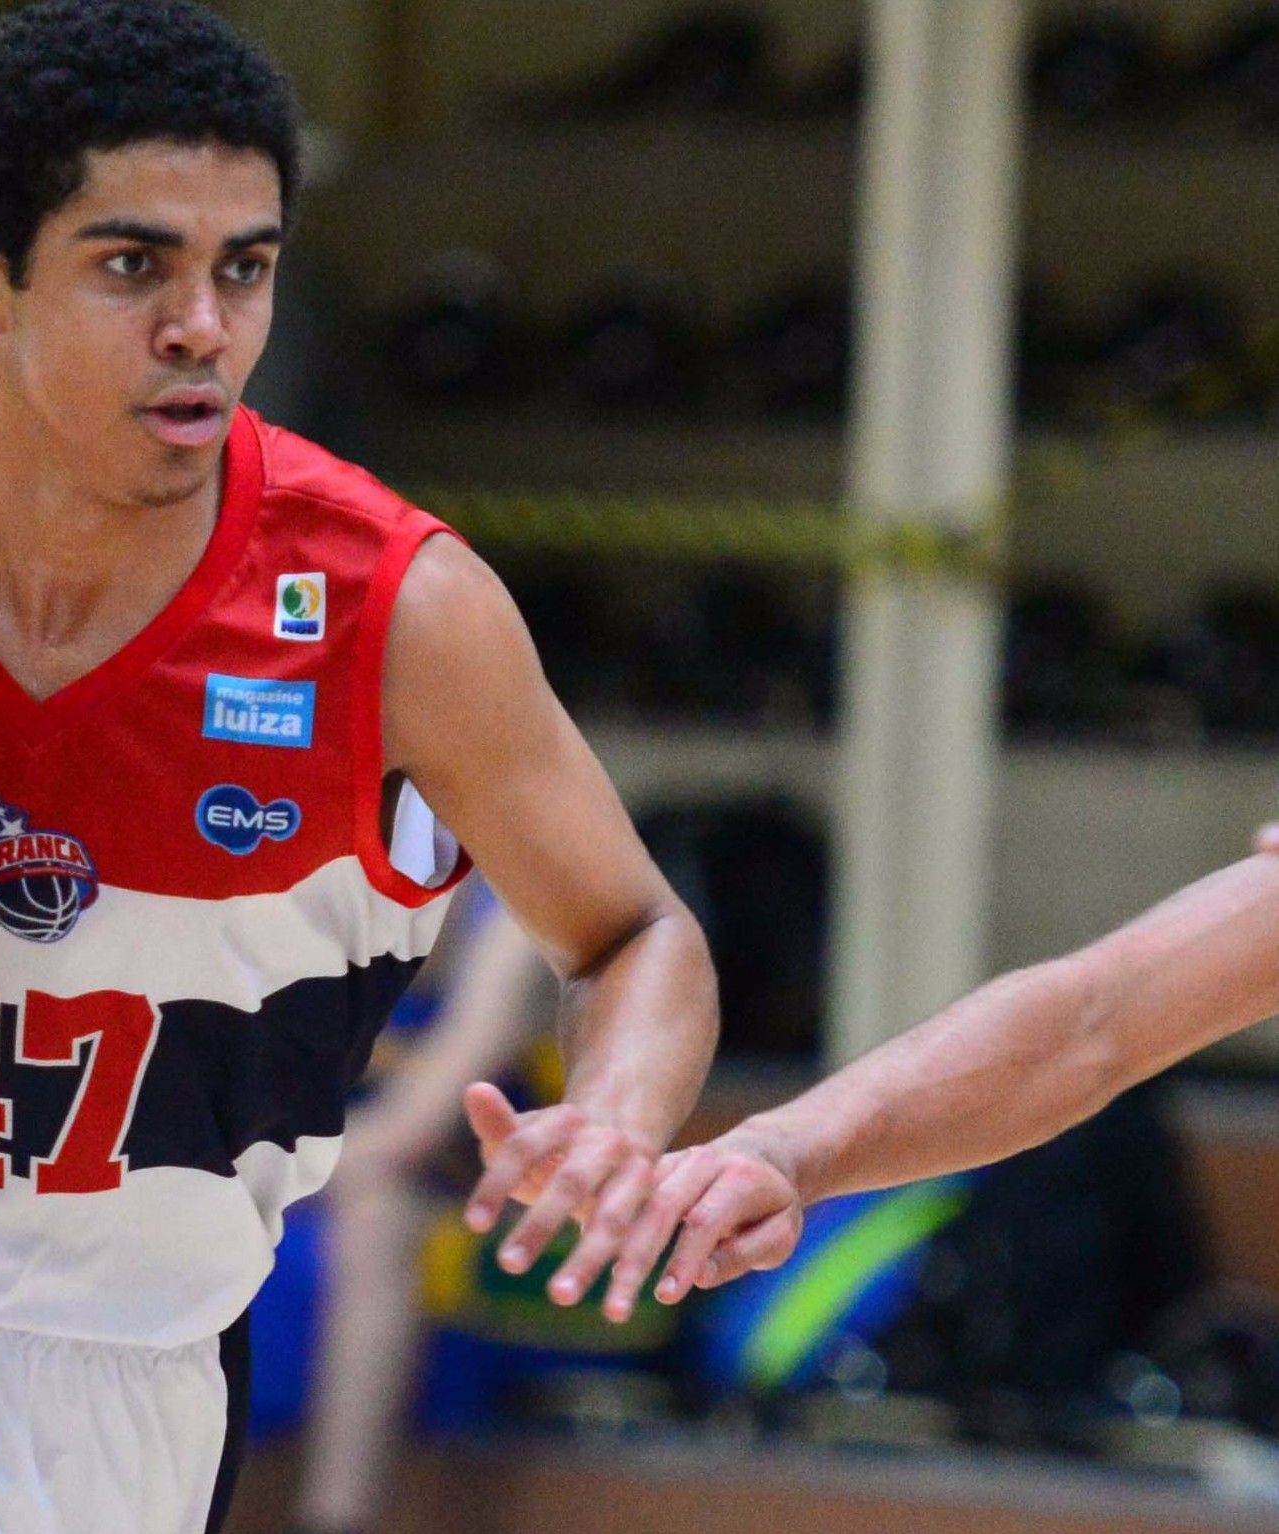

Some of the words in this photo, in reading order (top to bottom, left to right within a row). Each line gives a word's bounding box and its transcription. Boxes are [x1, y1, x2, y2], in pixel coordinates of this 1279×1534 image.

[215, 686, 304, 706] magazine
[213, 700, 302, 737] luiza
[206, 805, 289, 831] EMS
